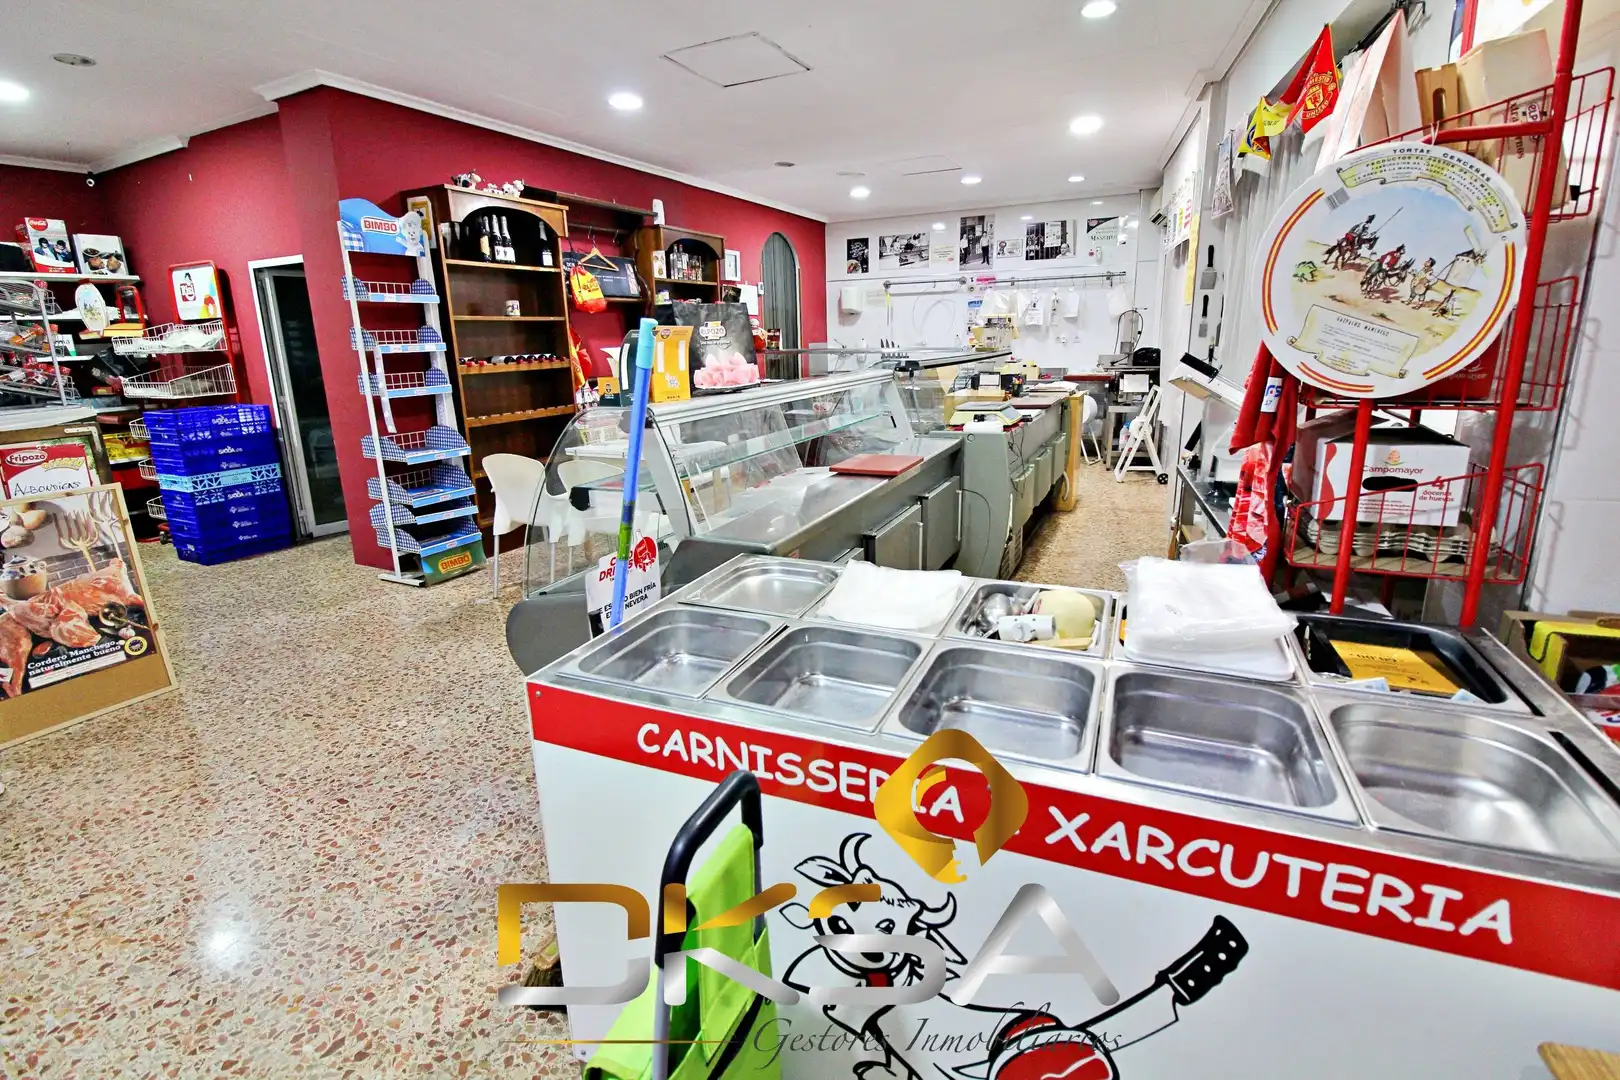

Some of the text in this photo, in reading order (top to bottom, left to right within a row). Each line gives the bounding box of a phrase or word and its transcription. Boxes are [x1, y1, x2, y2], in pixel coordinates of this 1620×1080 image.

[363, 219, 398, 232] BIMBO
[1362, 465, 1424, 475] Campomayor
[440, 553, 471, 571] BIMBO
[598, 560, 634, 582] DRIS
[629, 587, 643, 599] BIEN
[643, 581, 657, 593] FRÍA
[624, 593, 648, 609] NEVERA
[27, 653, 68, 670] Cordero
[28, 645, 121, 676] naturalmente bueno
[1044, 805, 1513, 945] XARCUTERIA
